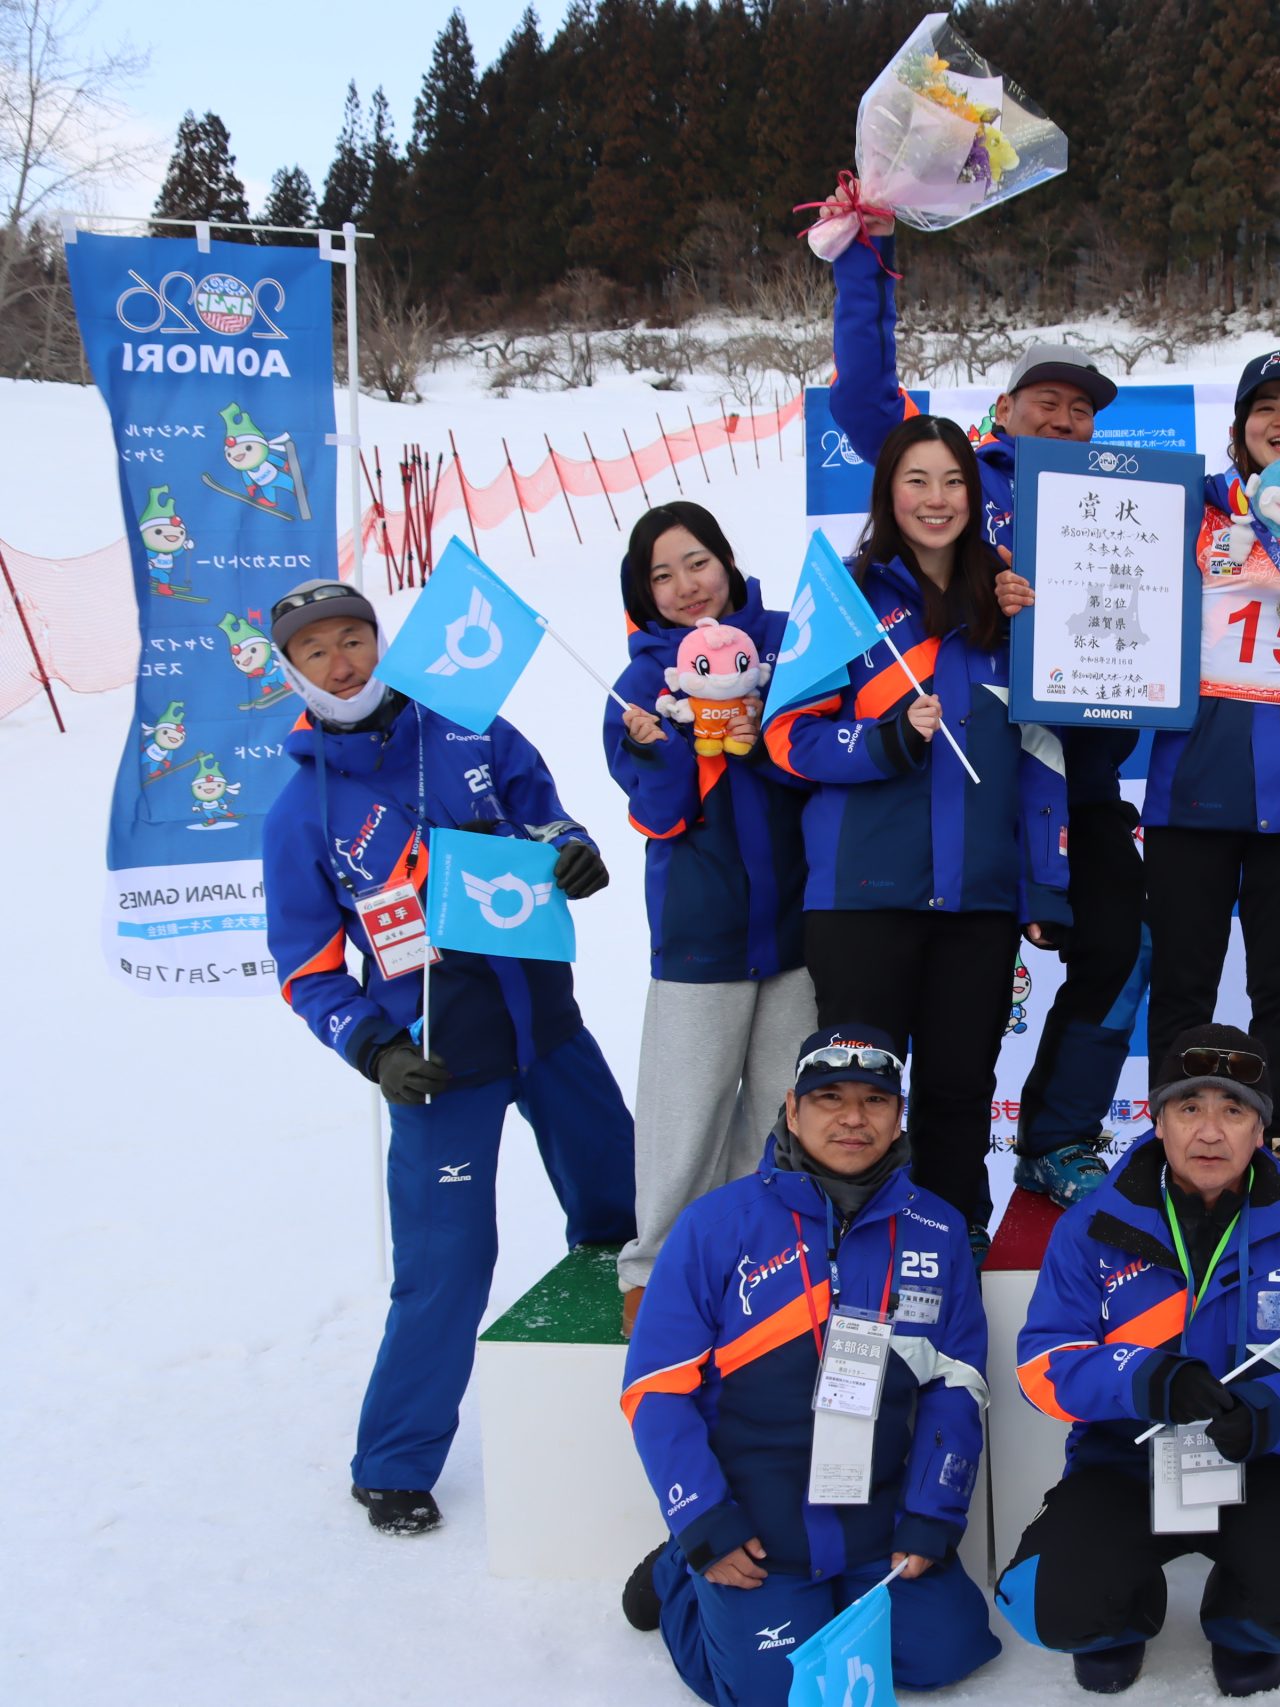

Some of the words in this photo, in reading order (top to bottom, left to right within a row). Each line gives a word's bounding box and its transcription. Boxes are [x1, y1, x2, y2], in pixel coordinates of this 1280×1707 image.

[1073, 562, 1145, 577] スキー競技会
[1089, 595, 1127, 609] 第2位
[1088, 616, 1126, 630] 滋賀県
[701, 708, 740, 720] 2025
[1083, 708, 1133, 720] AOMORI
[848, 723, 863, 753] ONYONE
[464, 764, 493, 794] 25
[438, 1175, 472, 1183] MIZUNO
[911, 1213, 949, 1233] ONYONE
[747, 1241, 810, 1289] SHIGA
[902, 1250, 940, 1279] 25
[831, 1339, 881, 1358] 本部役員
[667, 1492, 699, 1517] ONYONE
[757, 1636, 796, 1651] MIZUNO
